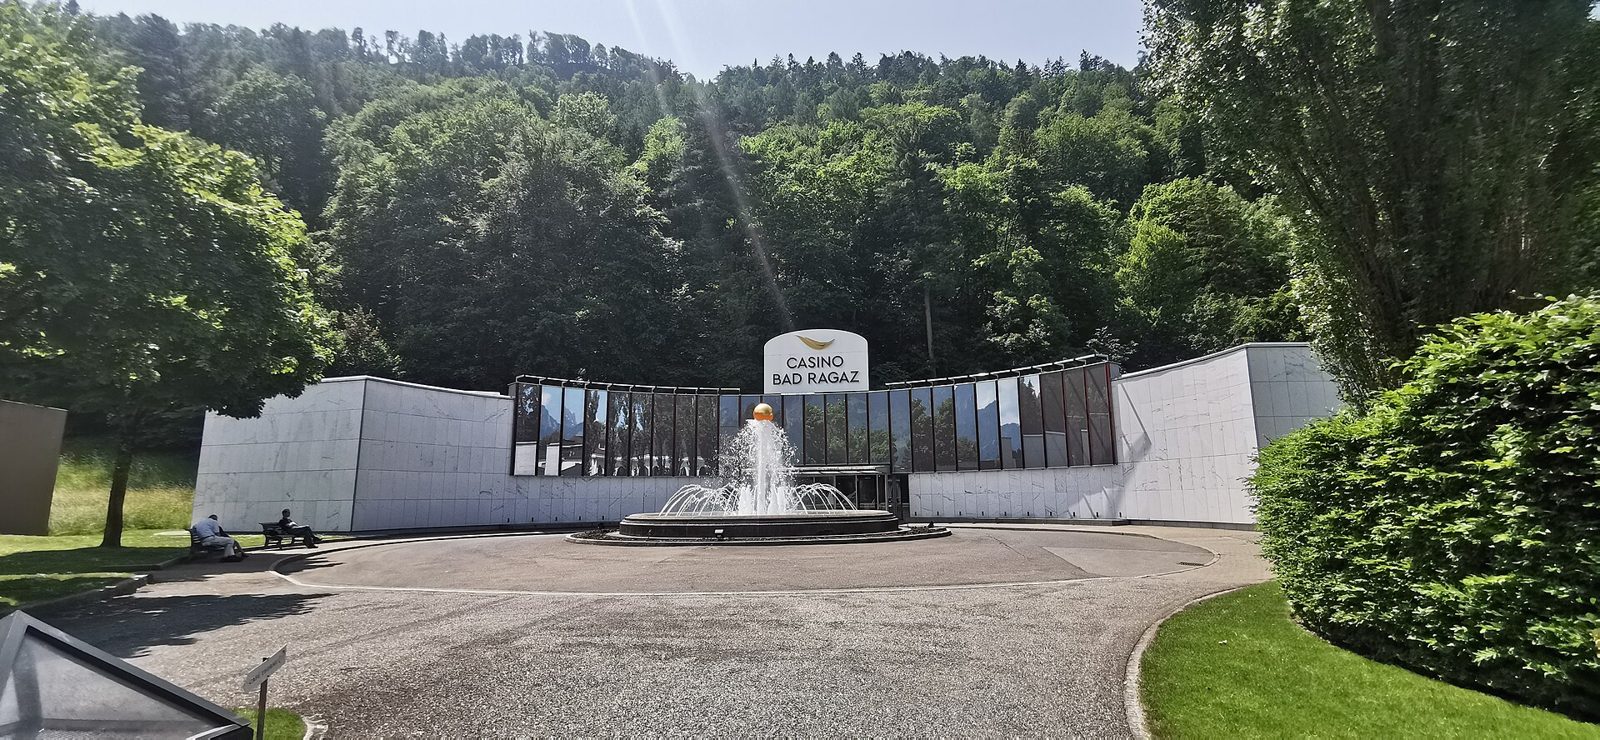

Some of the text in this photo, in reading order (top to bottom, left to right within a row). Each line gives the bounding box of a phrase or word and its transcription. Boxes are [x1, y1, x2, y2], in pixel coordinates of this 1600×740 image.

[786, 356, 843, 369] CASINO
[772, 371, 860, 385] BAD RAGAZ
